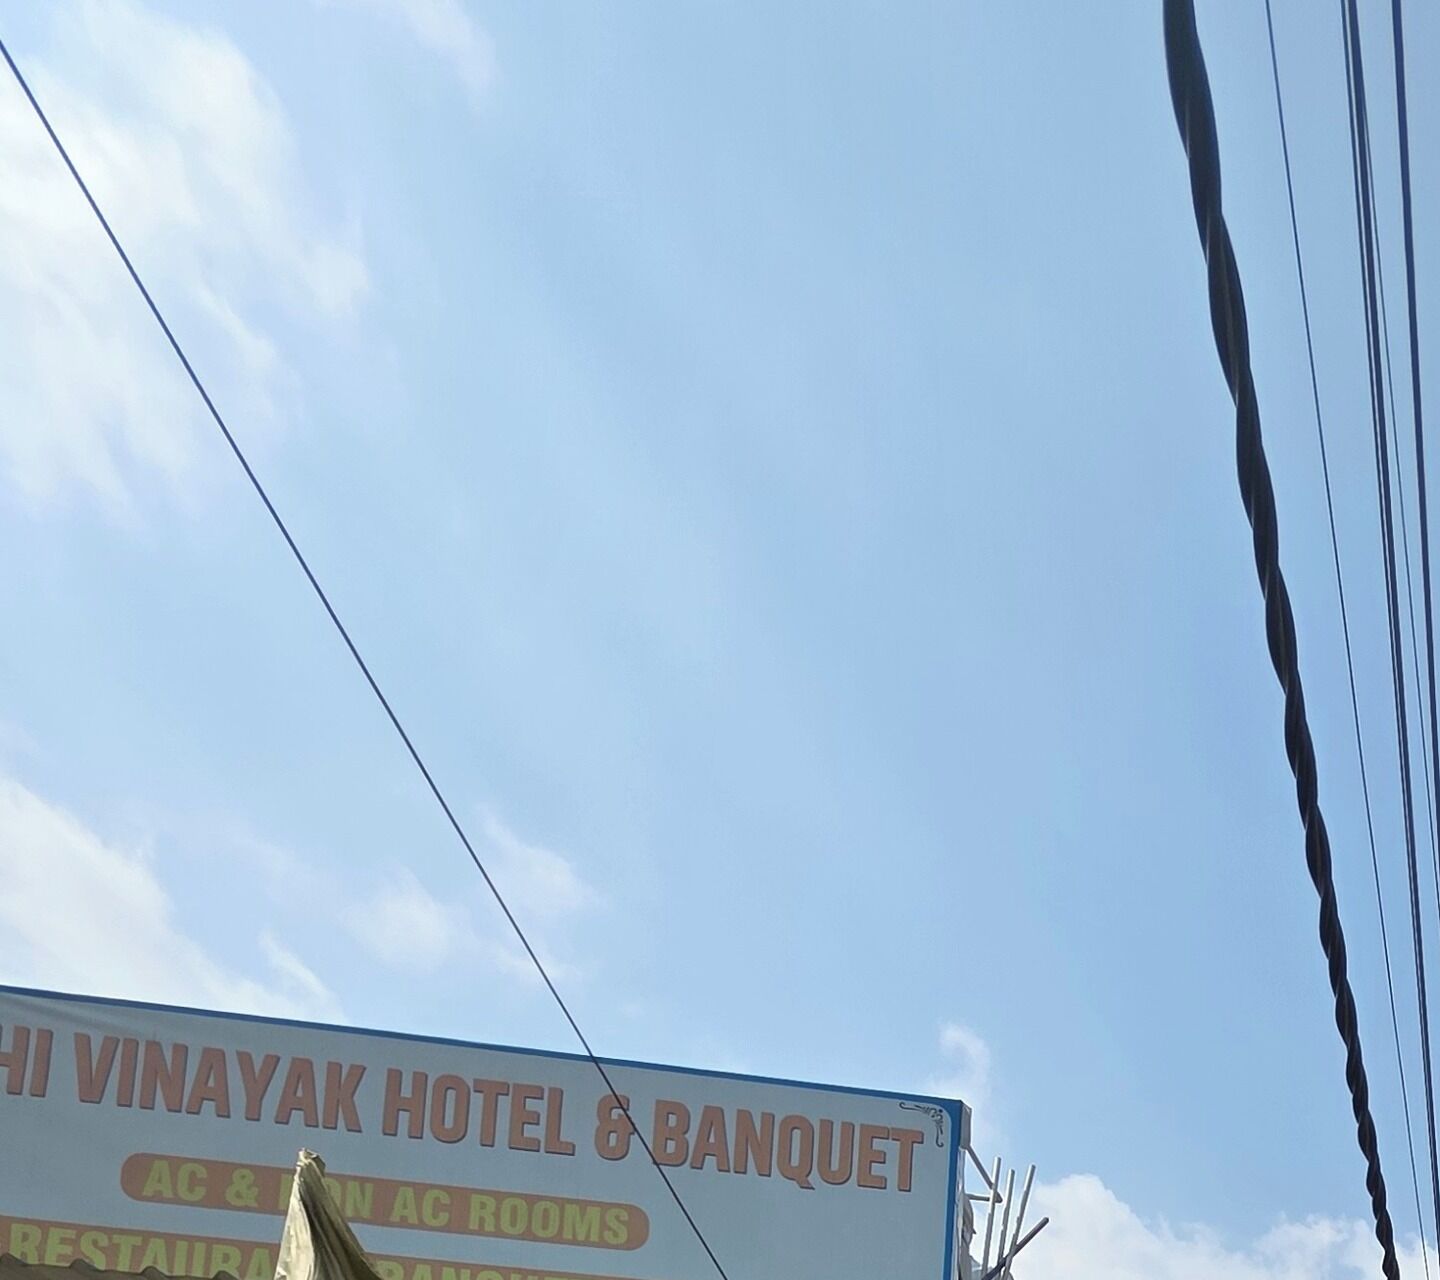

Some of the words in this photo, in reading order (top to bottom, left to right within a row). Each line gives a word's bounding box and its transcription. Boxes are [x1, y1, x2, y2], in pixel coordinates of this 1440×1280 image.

[74, 1031, 367, 1133] VINAYAK
[382, 1067, 576, 1156] HOTEL
[593, 1093, 636, 1161] &
[652, 1098, 925, 1193] BANQUET
[142, 1159, 208, 1202] AC
[225, 1167, 260, 1208] &
[389, 1185, 451, 1228] AC
[468, 1193, 630, 1246] ROOMS
